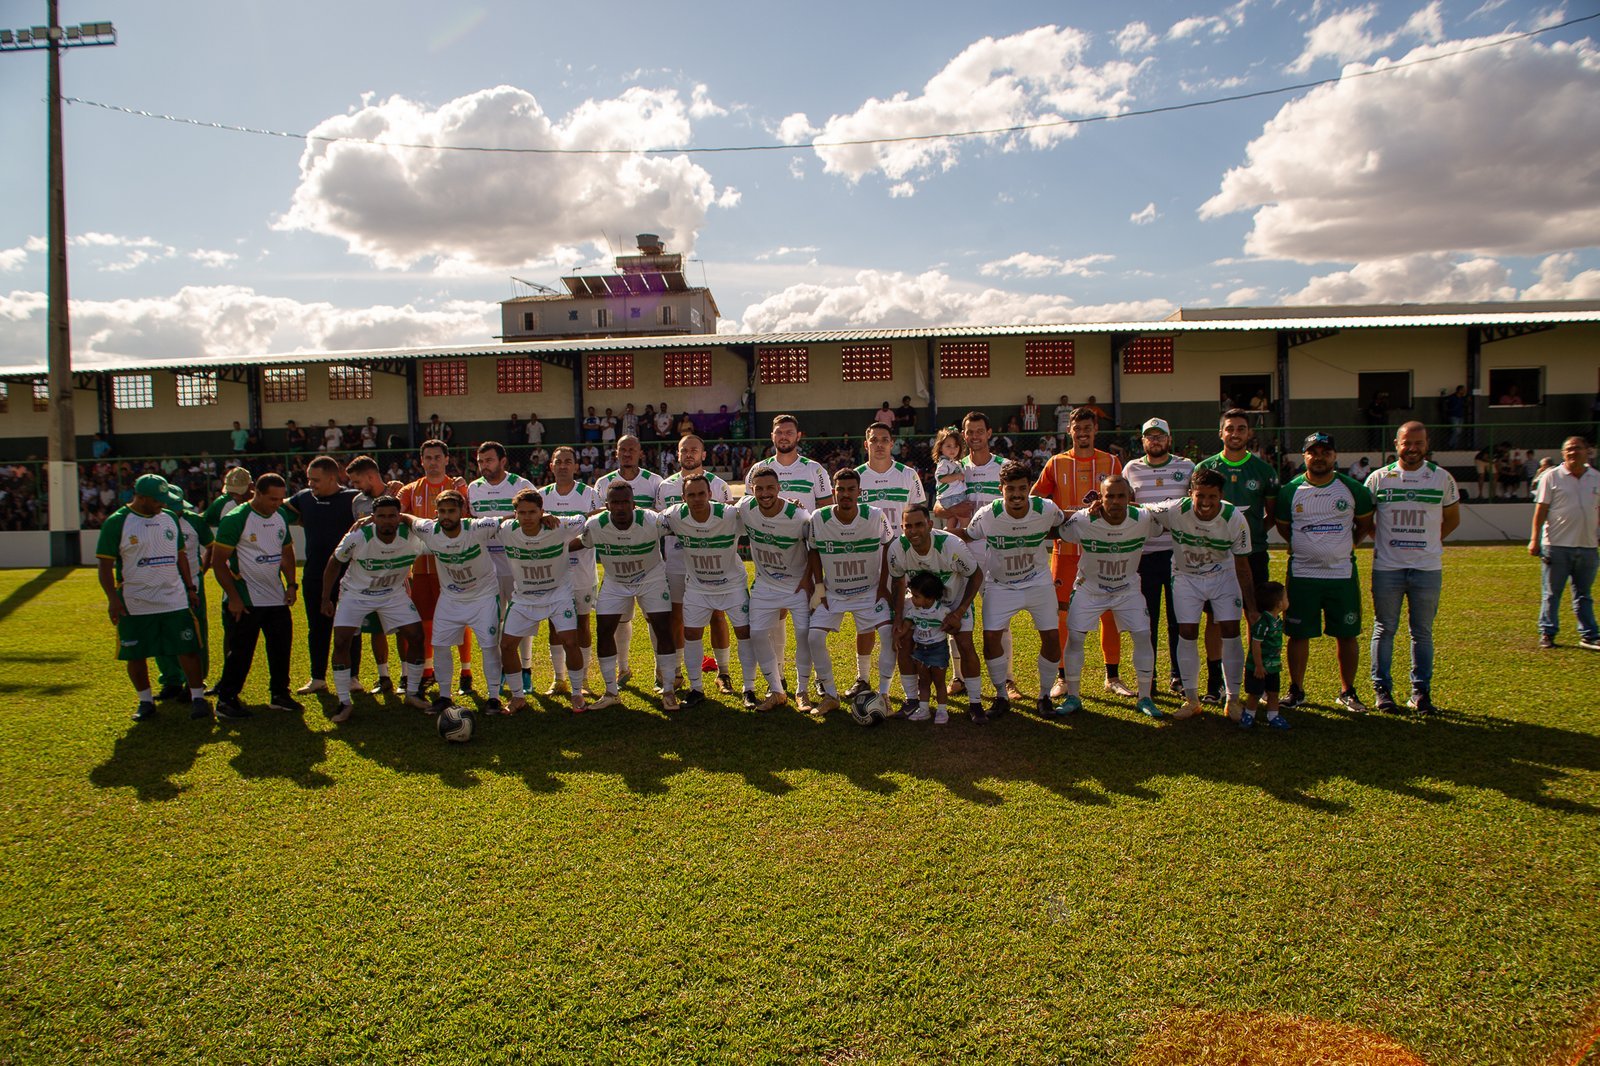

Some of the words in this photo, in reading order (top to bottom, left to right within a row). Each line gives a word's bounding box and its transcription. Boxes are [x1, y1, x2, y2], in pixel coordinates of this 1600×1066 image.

[1391, 509, 1427, 527] TMT
[824, 541, 834, 553] 16
[612, 559, 644, 574] TMT
[690, 554, 722, 569] TMT
[833, 559, 867, 577] TMT
[1004, 553, 1036, 571] TMT
[1097, 559, 1129, 576] TMT
[444, 566, 473, 580] TMT
[521, 564, 553, 580] TMT
